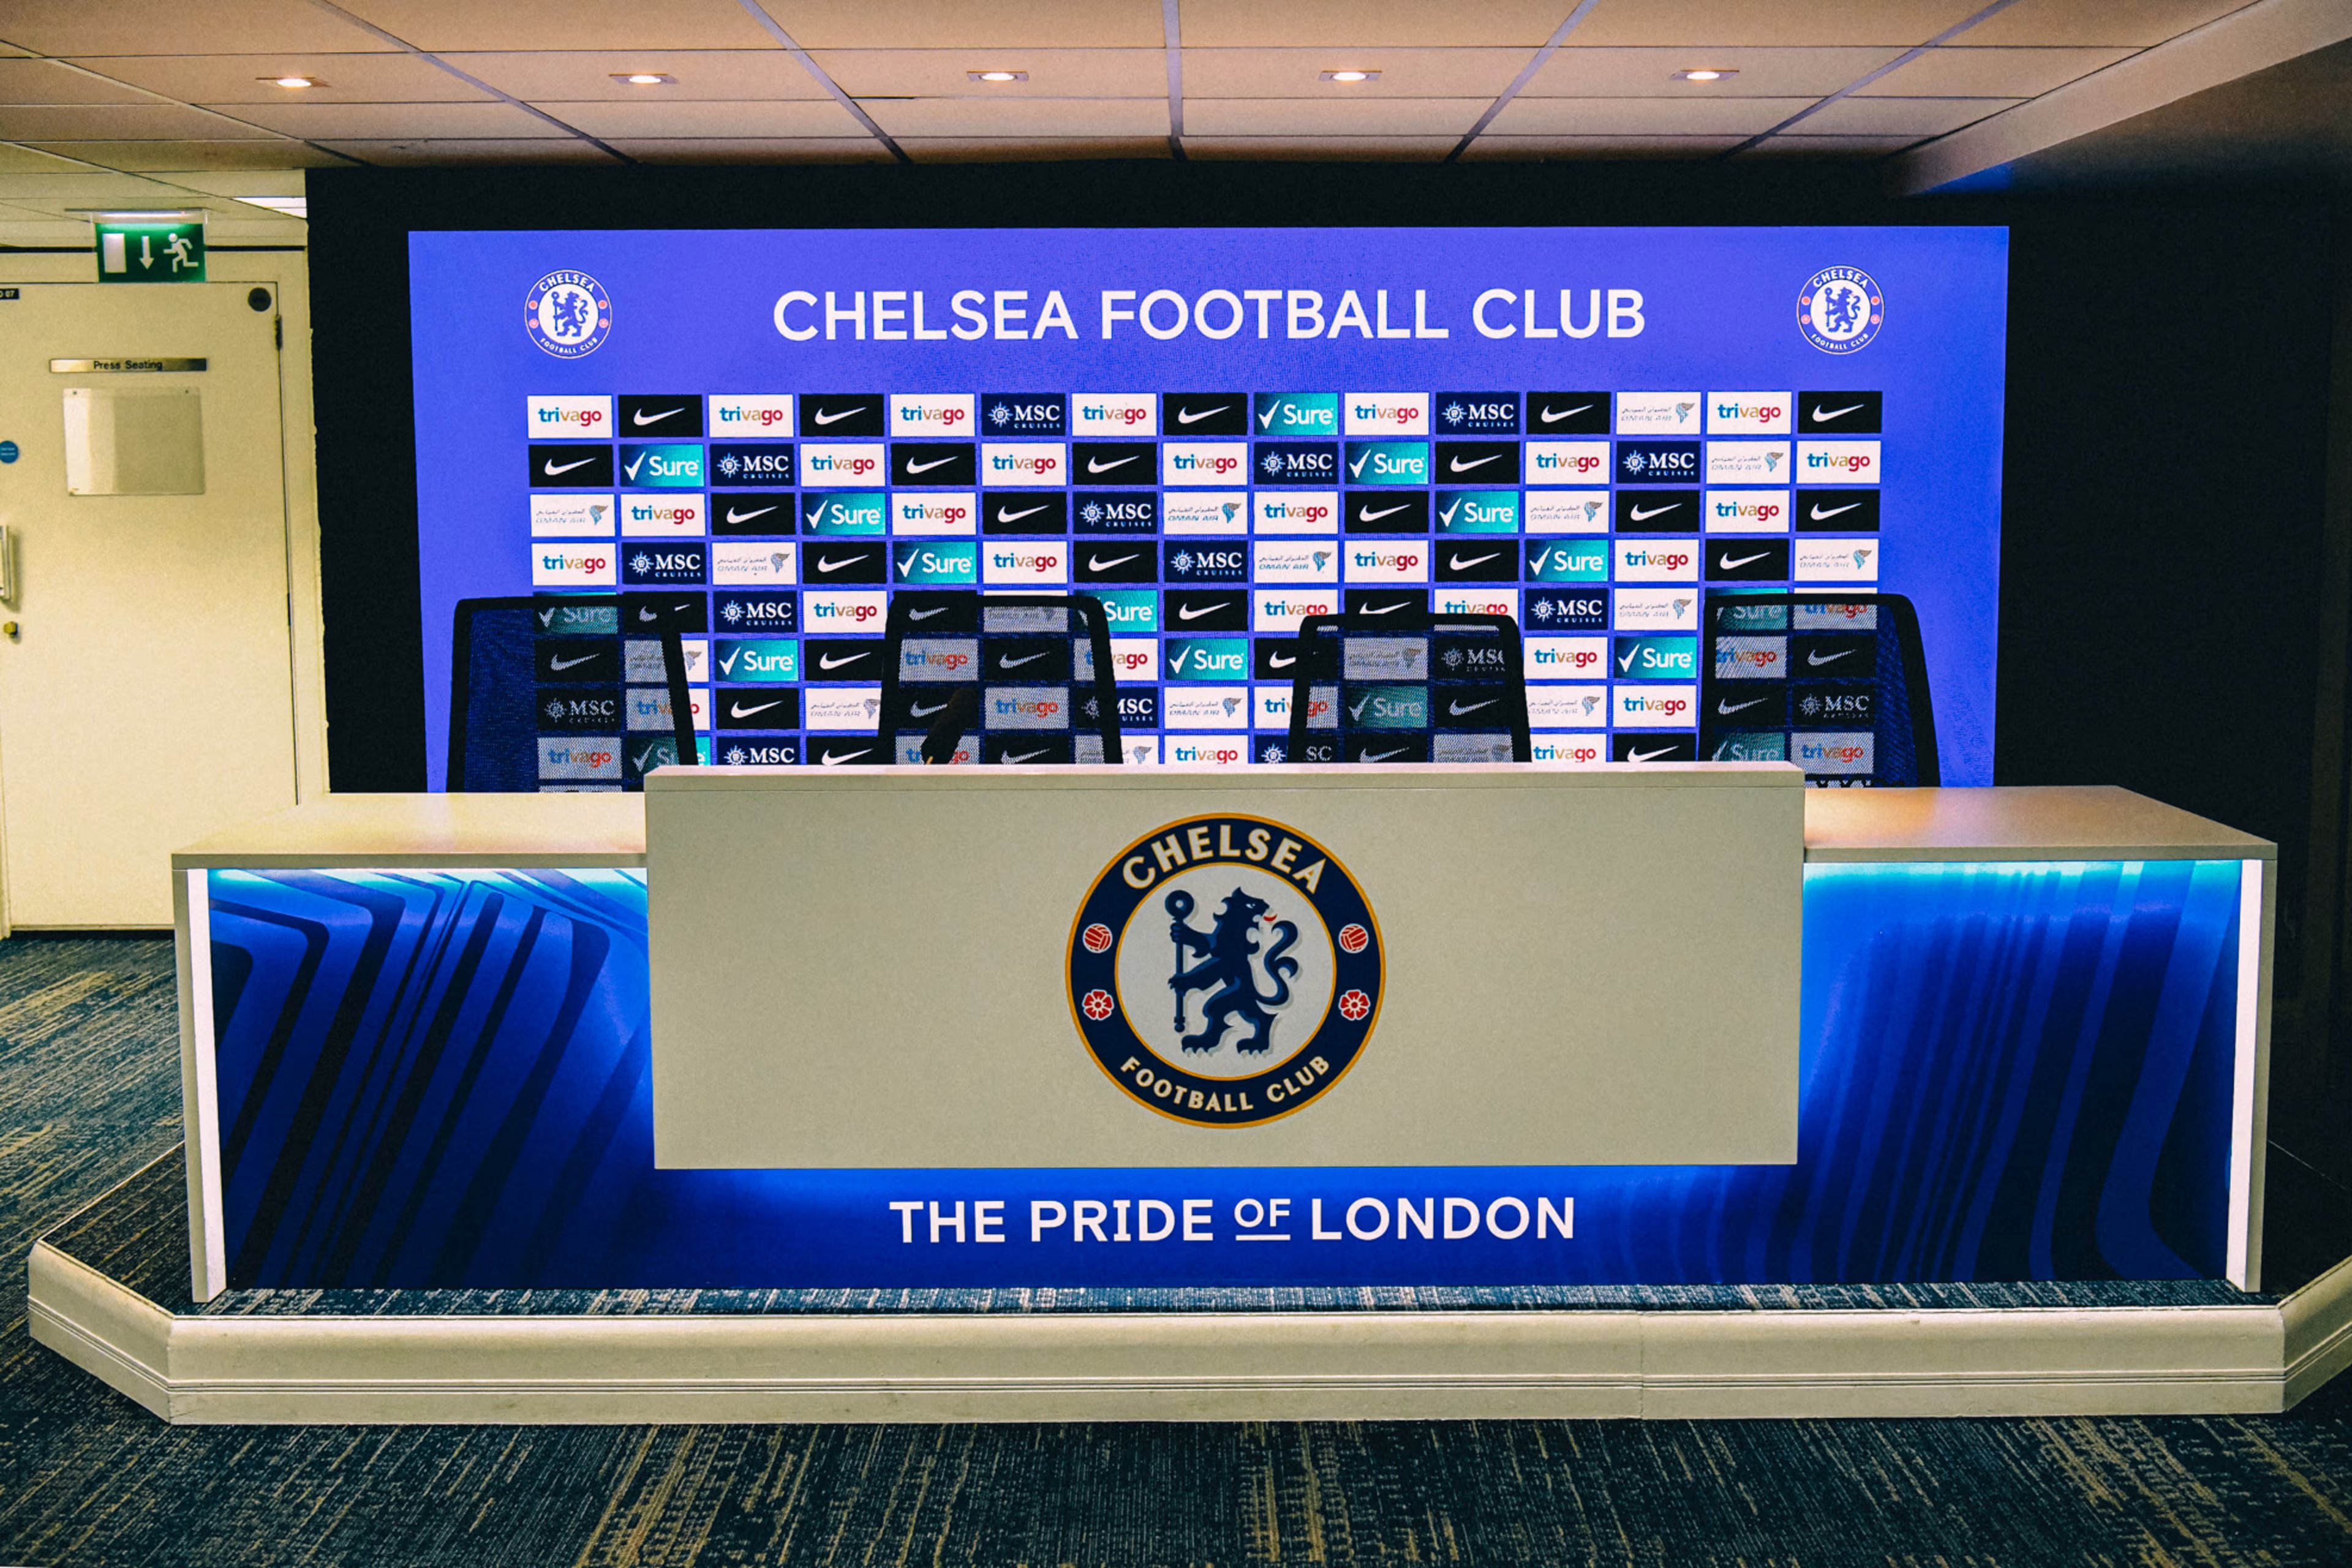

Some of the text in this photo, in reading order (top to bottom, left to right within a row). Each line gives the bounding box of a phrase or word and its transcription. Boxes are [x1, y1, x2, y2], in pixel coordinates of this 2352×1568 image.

[539, 273, 595, 292] CHELSEA
[1813, 270, 1868, 288] CHELSEA
[774, 289, 1645, 341] CHELSEA FOOTBALL CLUB
[94, 360, 163, 372] Press Seating
[538, 407, 602, 427] trivago
[719, 406, 783, 426] trivago
[900, 405, 965, 426] trivago
[1014, 405, 1060, 421] MSC
[1082, 405, 1147, 425] trivago
[1284, 405, 1332, 424] Sure
[1355, 404, 1419, 424] trivago
[1468, 404, 1513, 420] MSC
[1717, 403, 1781, 423] trivago
[650, 456, 698, 475] Sure
[743, 456, 788, 472] MSC
[810, 455, 875, 475] trivago
[992, 454, 1056, 475] trivago
[1173, 454, 1237, 474] trivago
[1287, 454, 1332, 470] MSC
[1374, 454, 1423, 473] Sure
[1536, 453, 1600, 473] trivago
[1649, 453, 1694, 469] MSC
[1806, 452, 1871, 472] trivago
[631, 505, 695, 525] trivago
[832, 505, 880, 524] Sure
[902, 504, 966, 524] trivago
[1106, 503, 1151, 519] MSC
[1264, 503, 1328, 523] trivago
[1465, 503, 1513, 522] Sure
[1716, 501, 1780, 521] trivago
[542, 554, 606, 575] trivago
[655, 554, 700, 570] MSC
[923, 553, 971, 573] Sure
[993, 552, 1057, 573] trivago
[1197, 552, 1242, 568] MSC
[1354, 551, 1419, 571] trivago
[1555, 551, 1603, 571] Sure
[1624, 551, 1689, 571] trivago
[746, 602, 791, 618] MSC
[813, 602, 878, 622] trivago
[1104, 601, 1152, 620] Sure
[1557, 600, 1602, 616] MSC
[744, 651, 793, 671] Sure
[904, 650, 968, 670] trivago
[1194, 650, 1243, 669] Sure
[1534, 648, 1598, 668] trivago
[1644, 648, 1692, 668] Sure
[569, 700, 614, 716] MSC
[995, 698, 1059, 718] trivago
[1374, 698, 1423, 717] Sure
[1623, 696, 1687, 716] trivago
[1825, 695, 1870, 711] MSC
[548, 748, 612, 768] trivago
[750, 747, 795, 763] MSC
[1175, 745, 1239, 764] trivago
[1533, 744, 1597, 763] trivago
[1801, 744, 1865, 764] trivago
[1123, 825, 1326, 894] CHELSEA
[1120, 1055, 1330, 1112] FOOTBALL CLUB
[890, 1197, 1573, 1242] THE PRIDE OF LONDON
